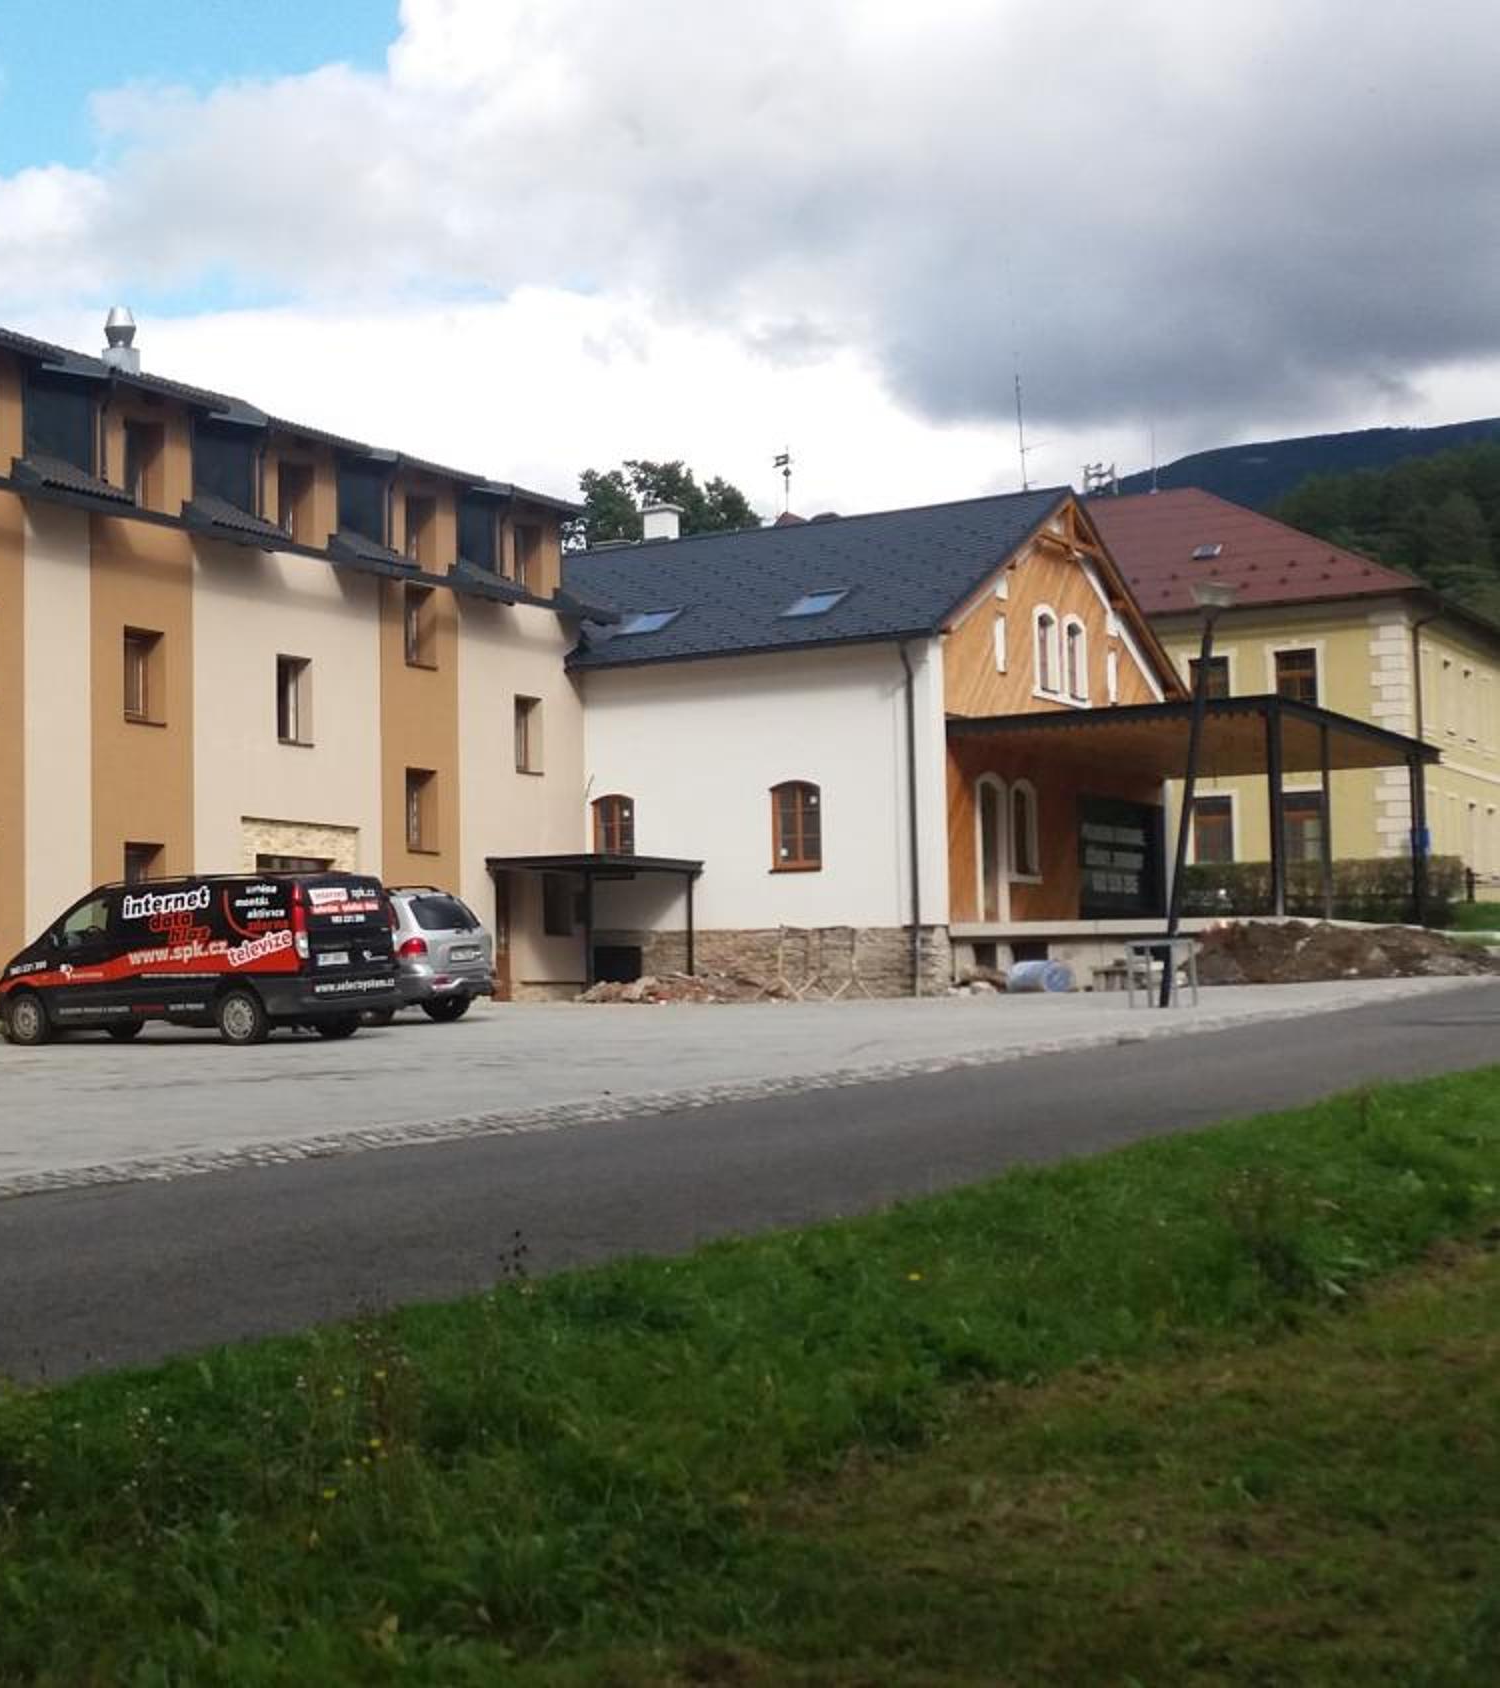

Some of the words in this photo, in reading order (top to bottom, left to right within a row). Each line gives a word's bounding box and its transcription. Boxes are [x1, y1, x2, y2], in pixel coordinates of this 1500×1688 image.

[122, 885, 210, 919] internet
[151, 912, 194, 931] data
[128, 940, 229, 965] www.spk.cz
[227, 930, 293, 967] televize
